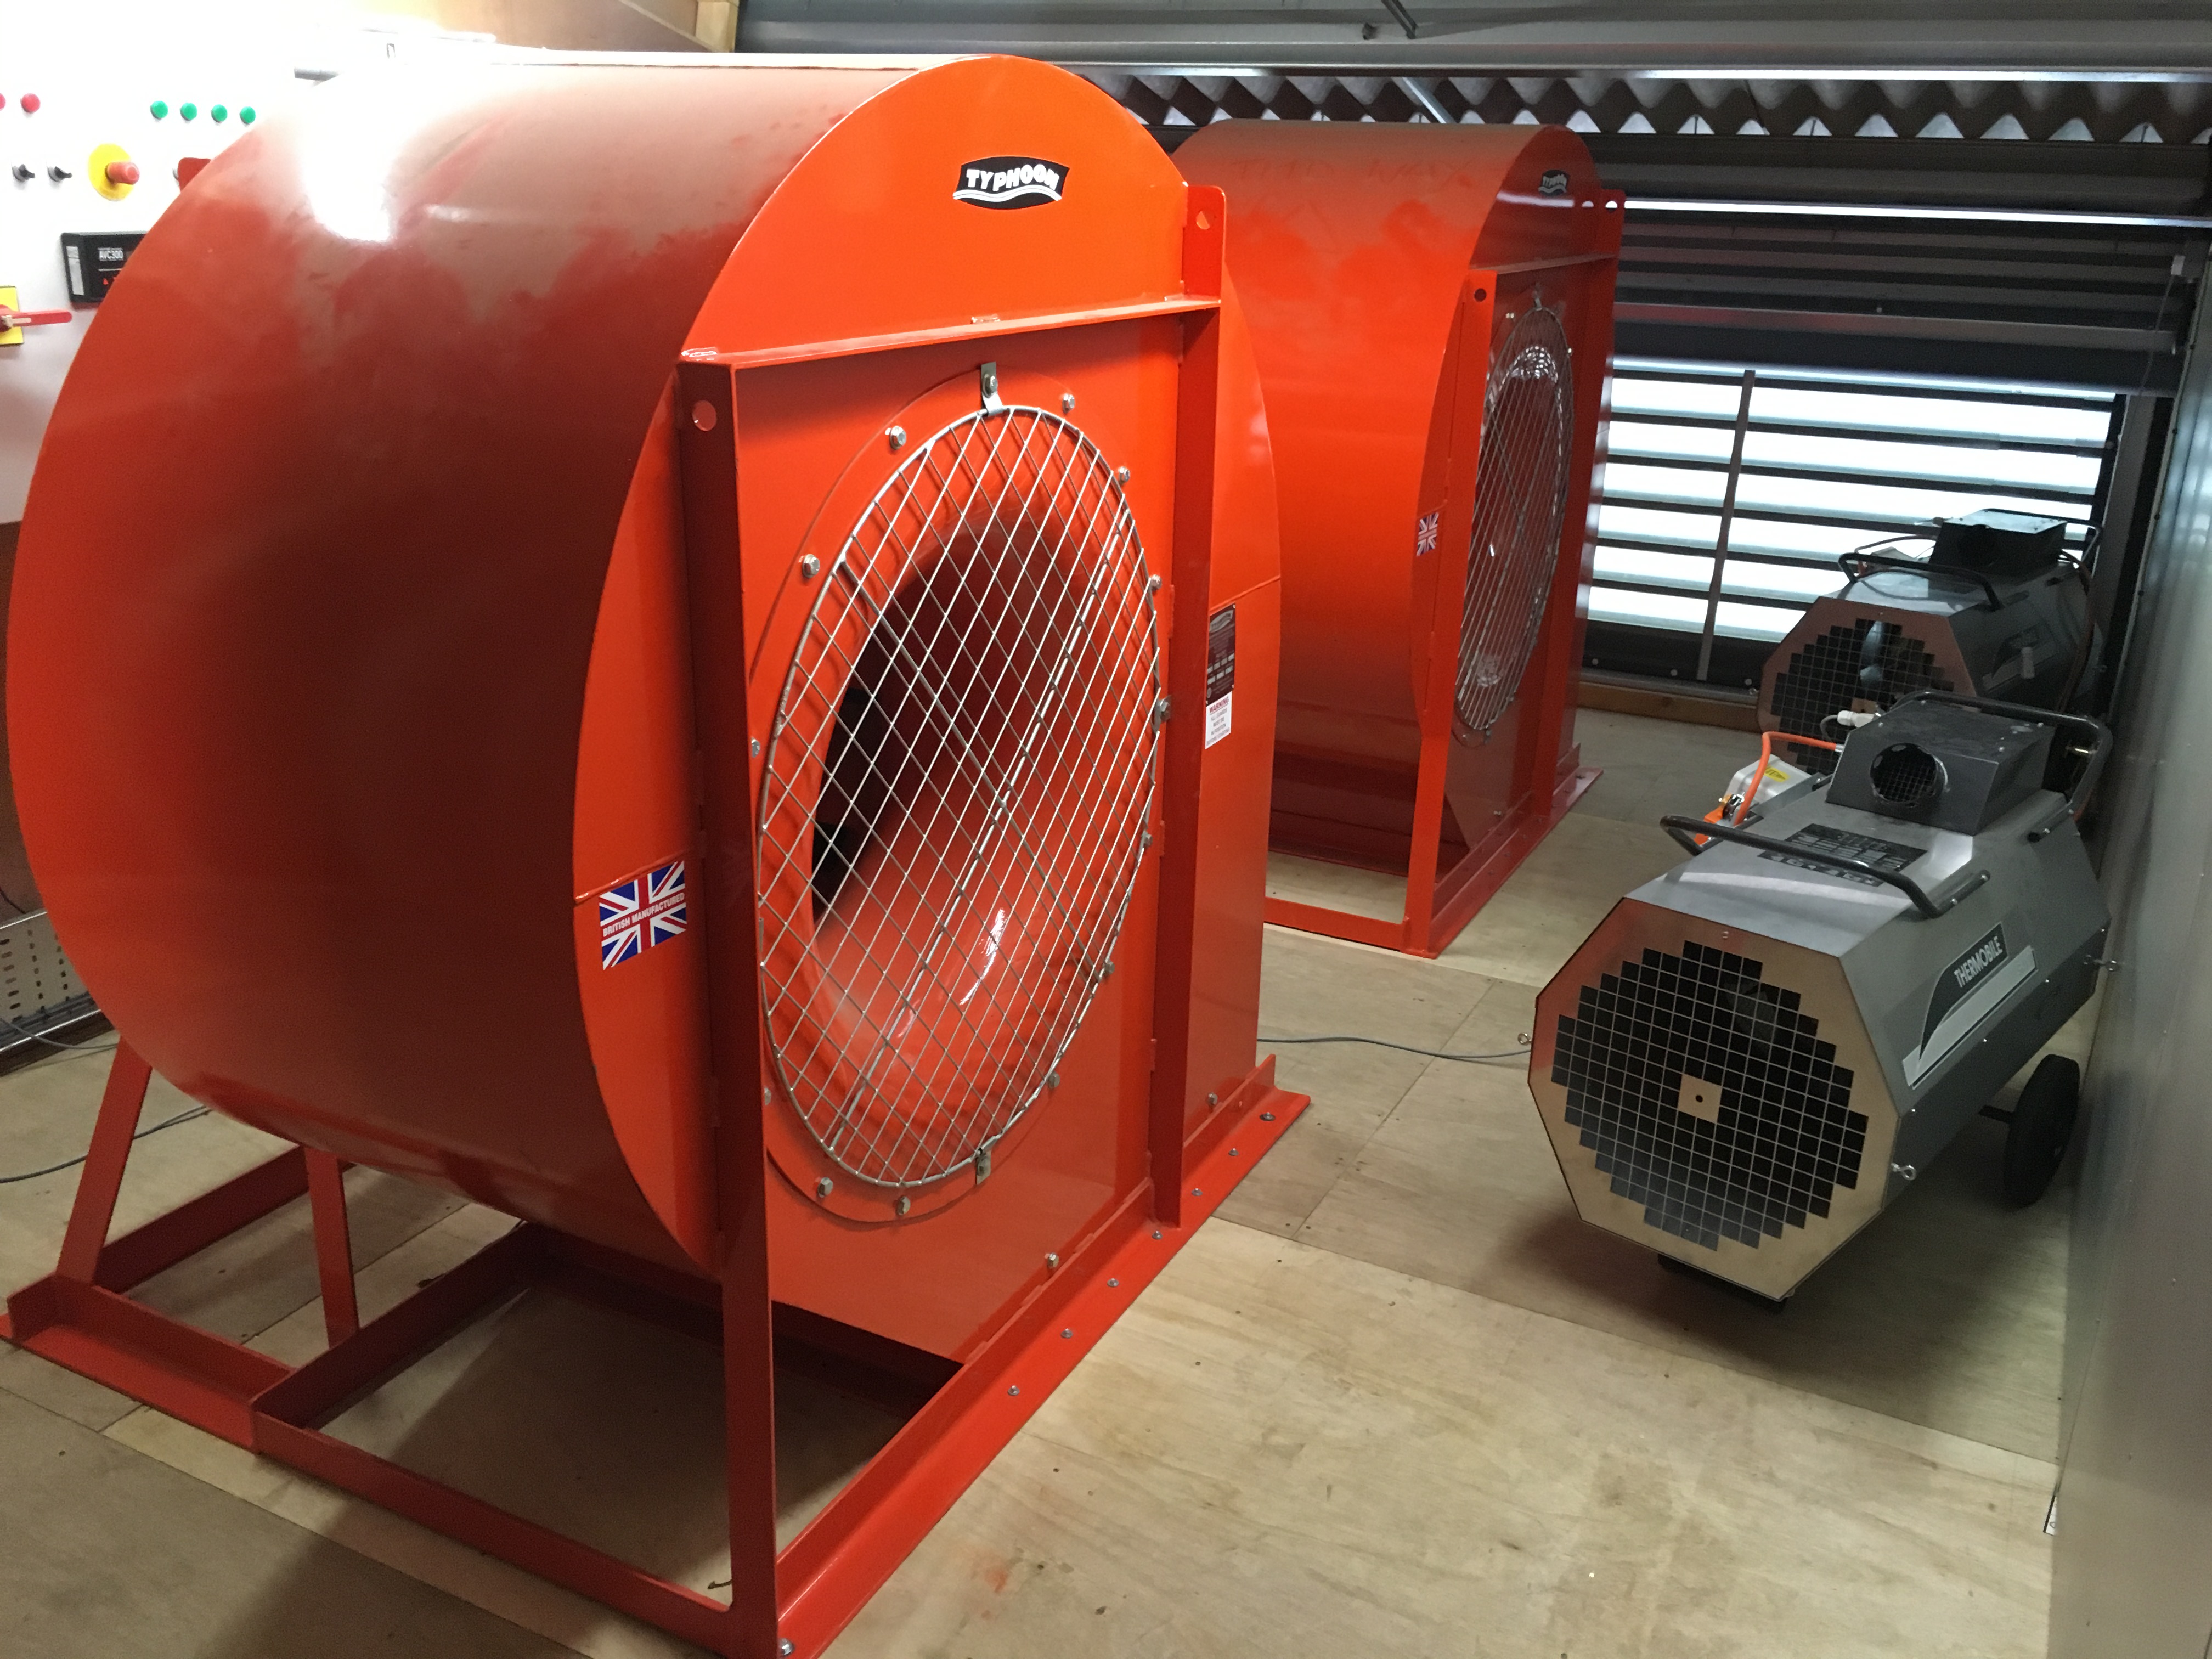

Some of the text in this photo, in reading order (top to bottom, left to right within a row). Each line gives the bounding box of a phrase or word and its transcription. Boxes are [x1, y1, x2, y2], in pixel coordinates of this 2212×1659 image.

[966, 164, 1060, 191] TYPHOON
[603, 893, 685, 937] BRITISH MANUFACTURED
[1954, 936, 2002, 988] THERMOBILE
